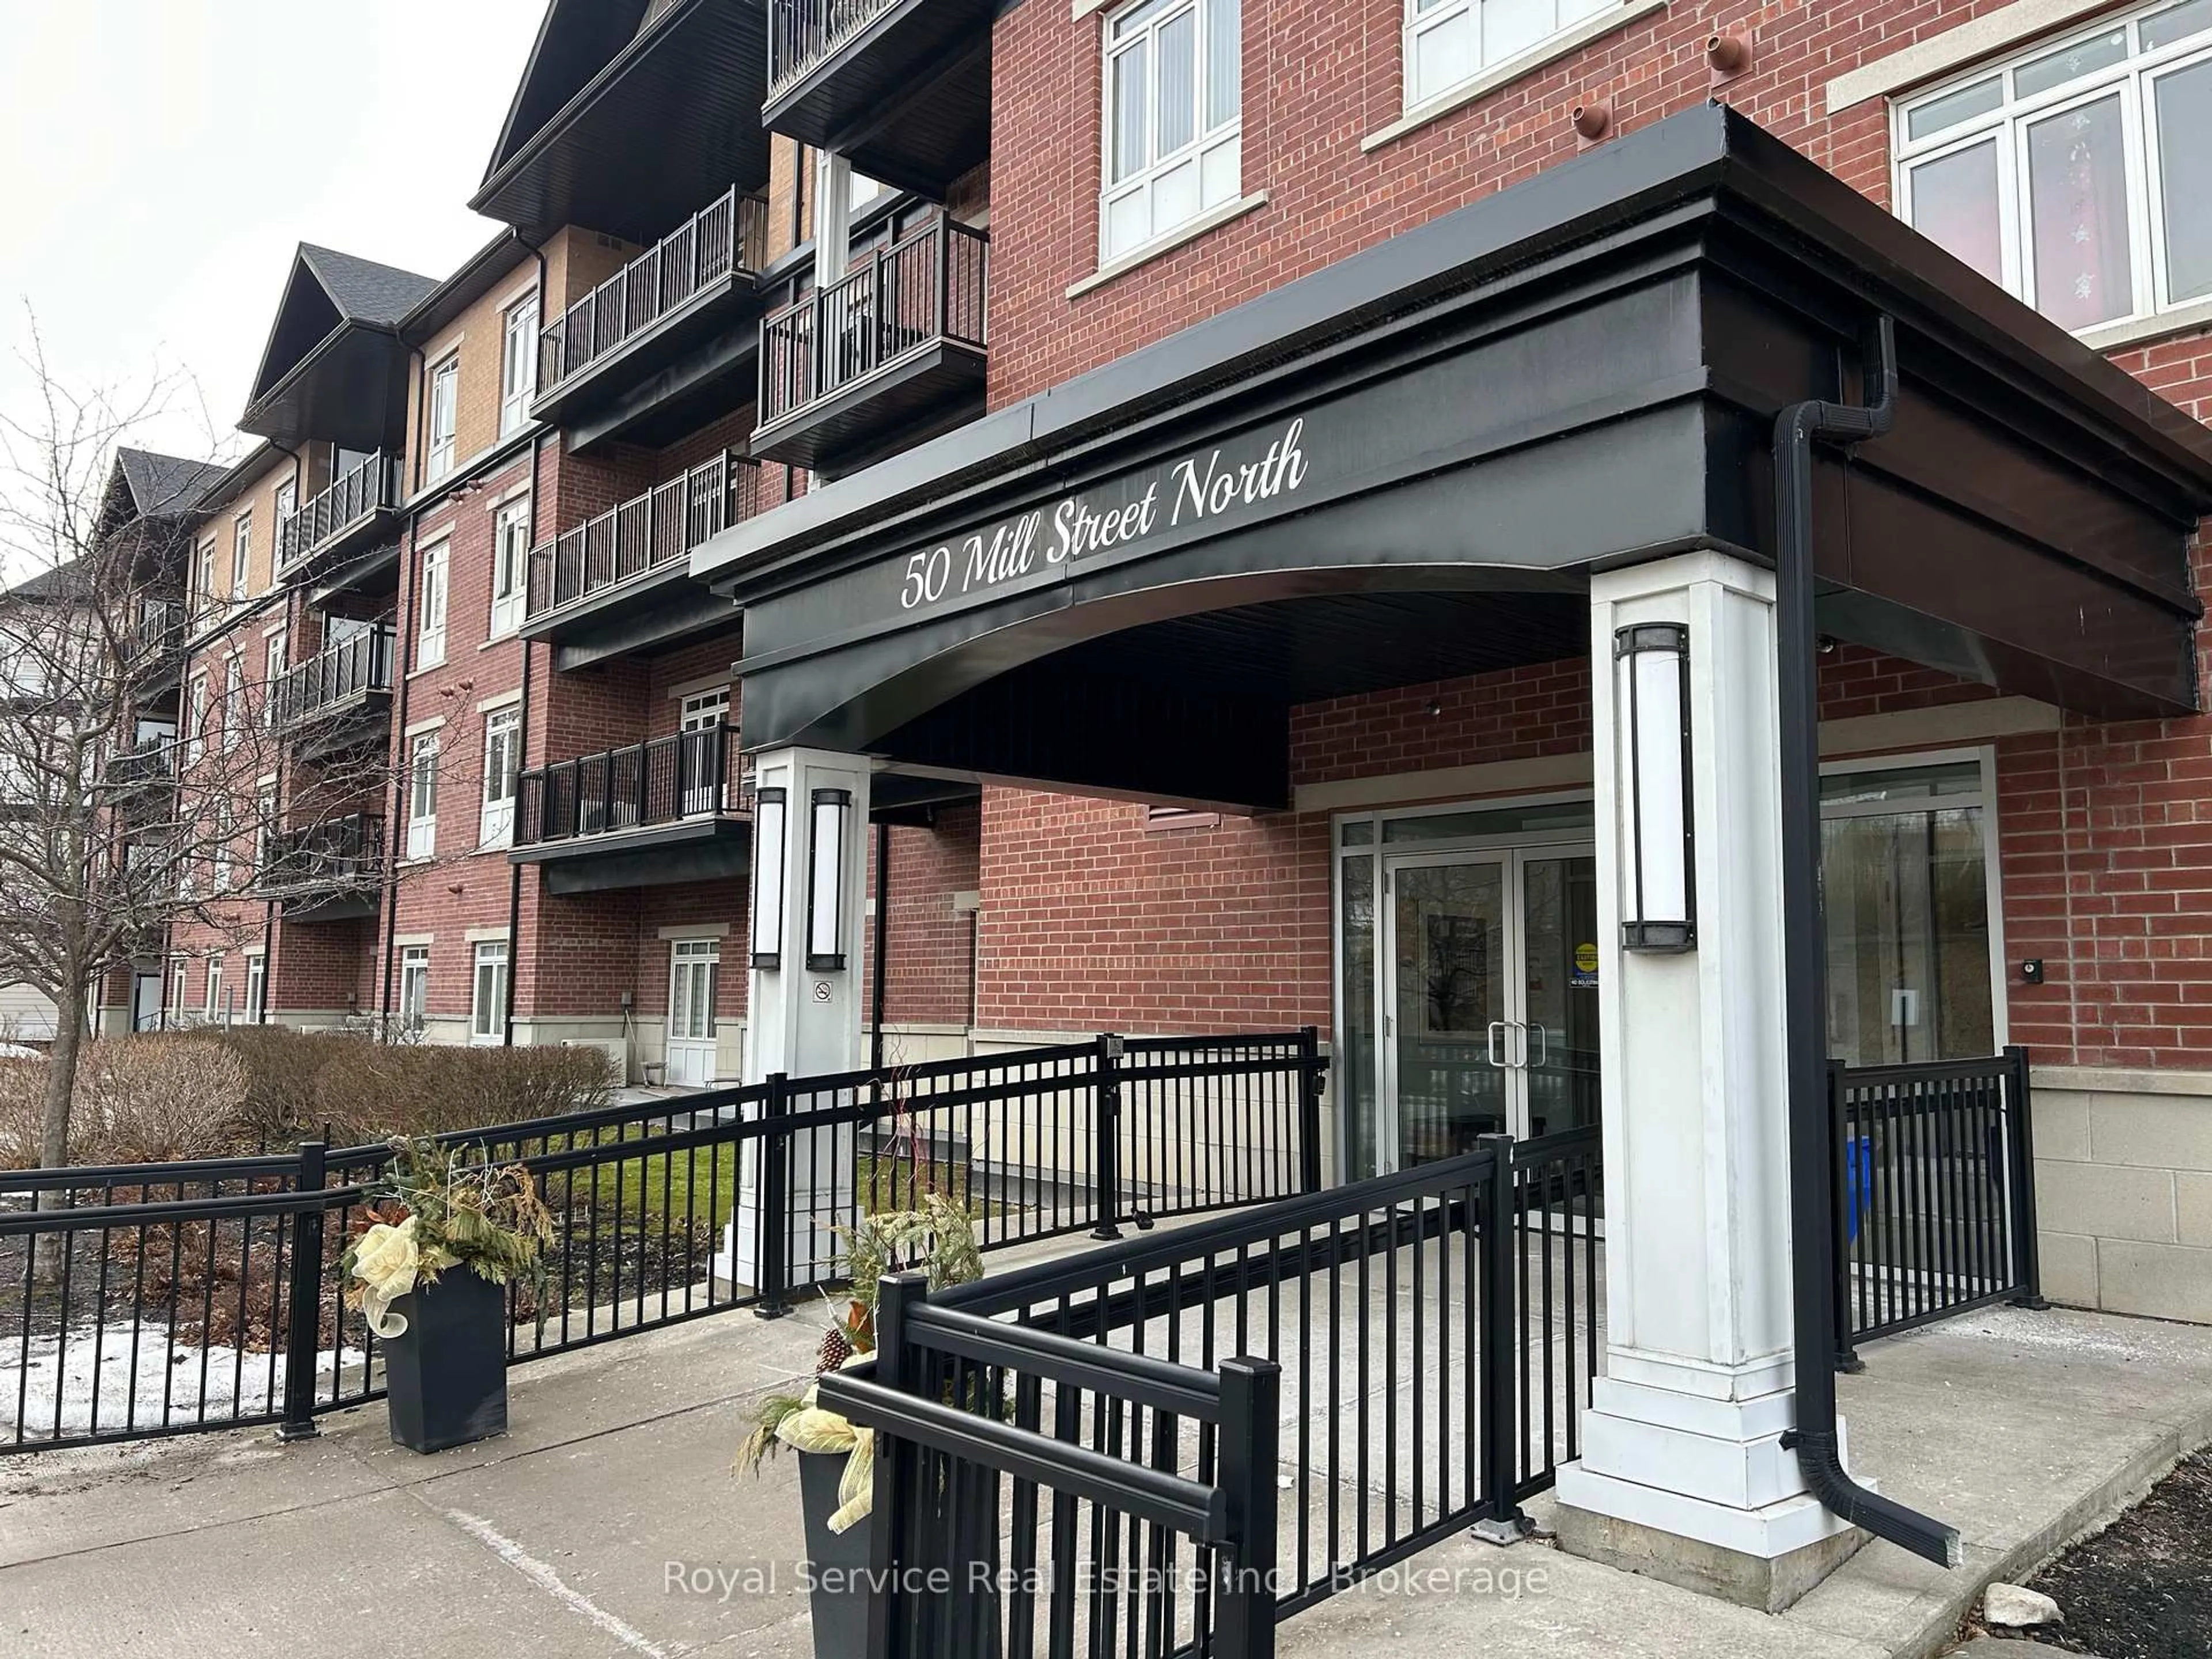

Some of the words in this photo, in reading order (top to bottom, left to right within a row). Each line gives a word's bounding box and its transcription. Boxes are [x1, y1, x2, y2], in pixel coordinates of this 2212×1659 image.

[902, 547, 951, 608] 50
[962, 511, 1041, 592] Mill
[1047, 482, 1157, 563] Street
[1171, 418, 1308, 526] North
